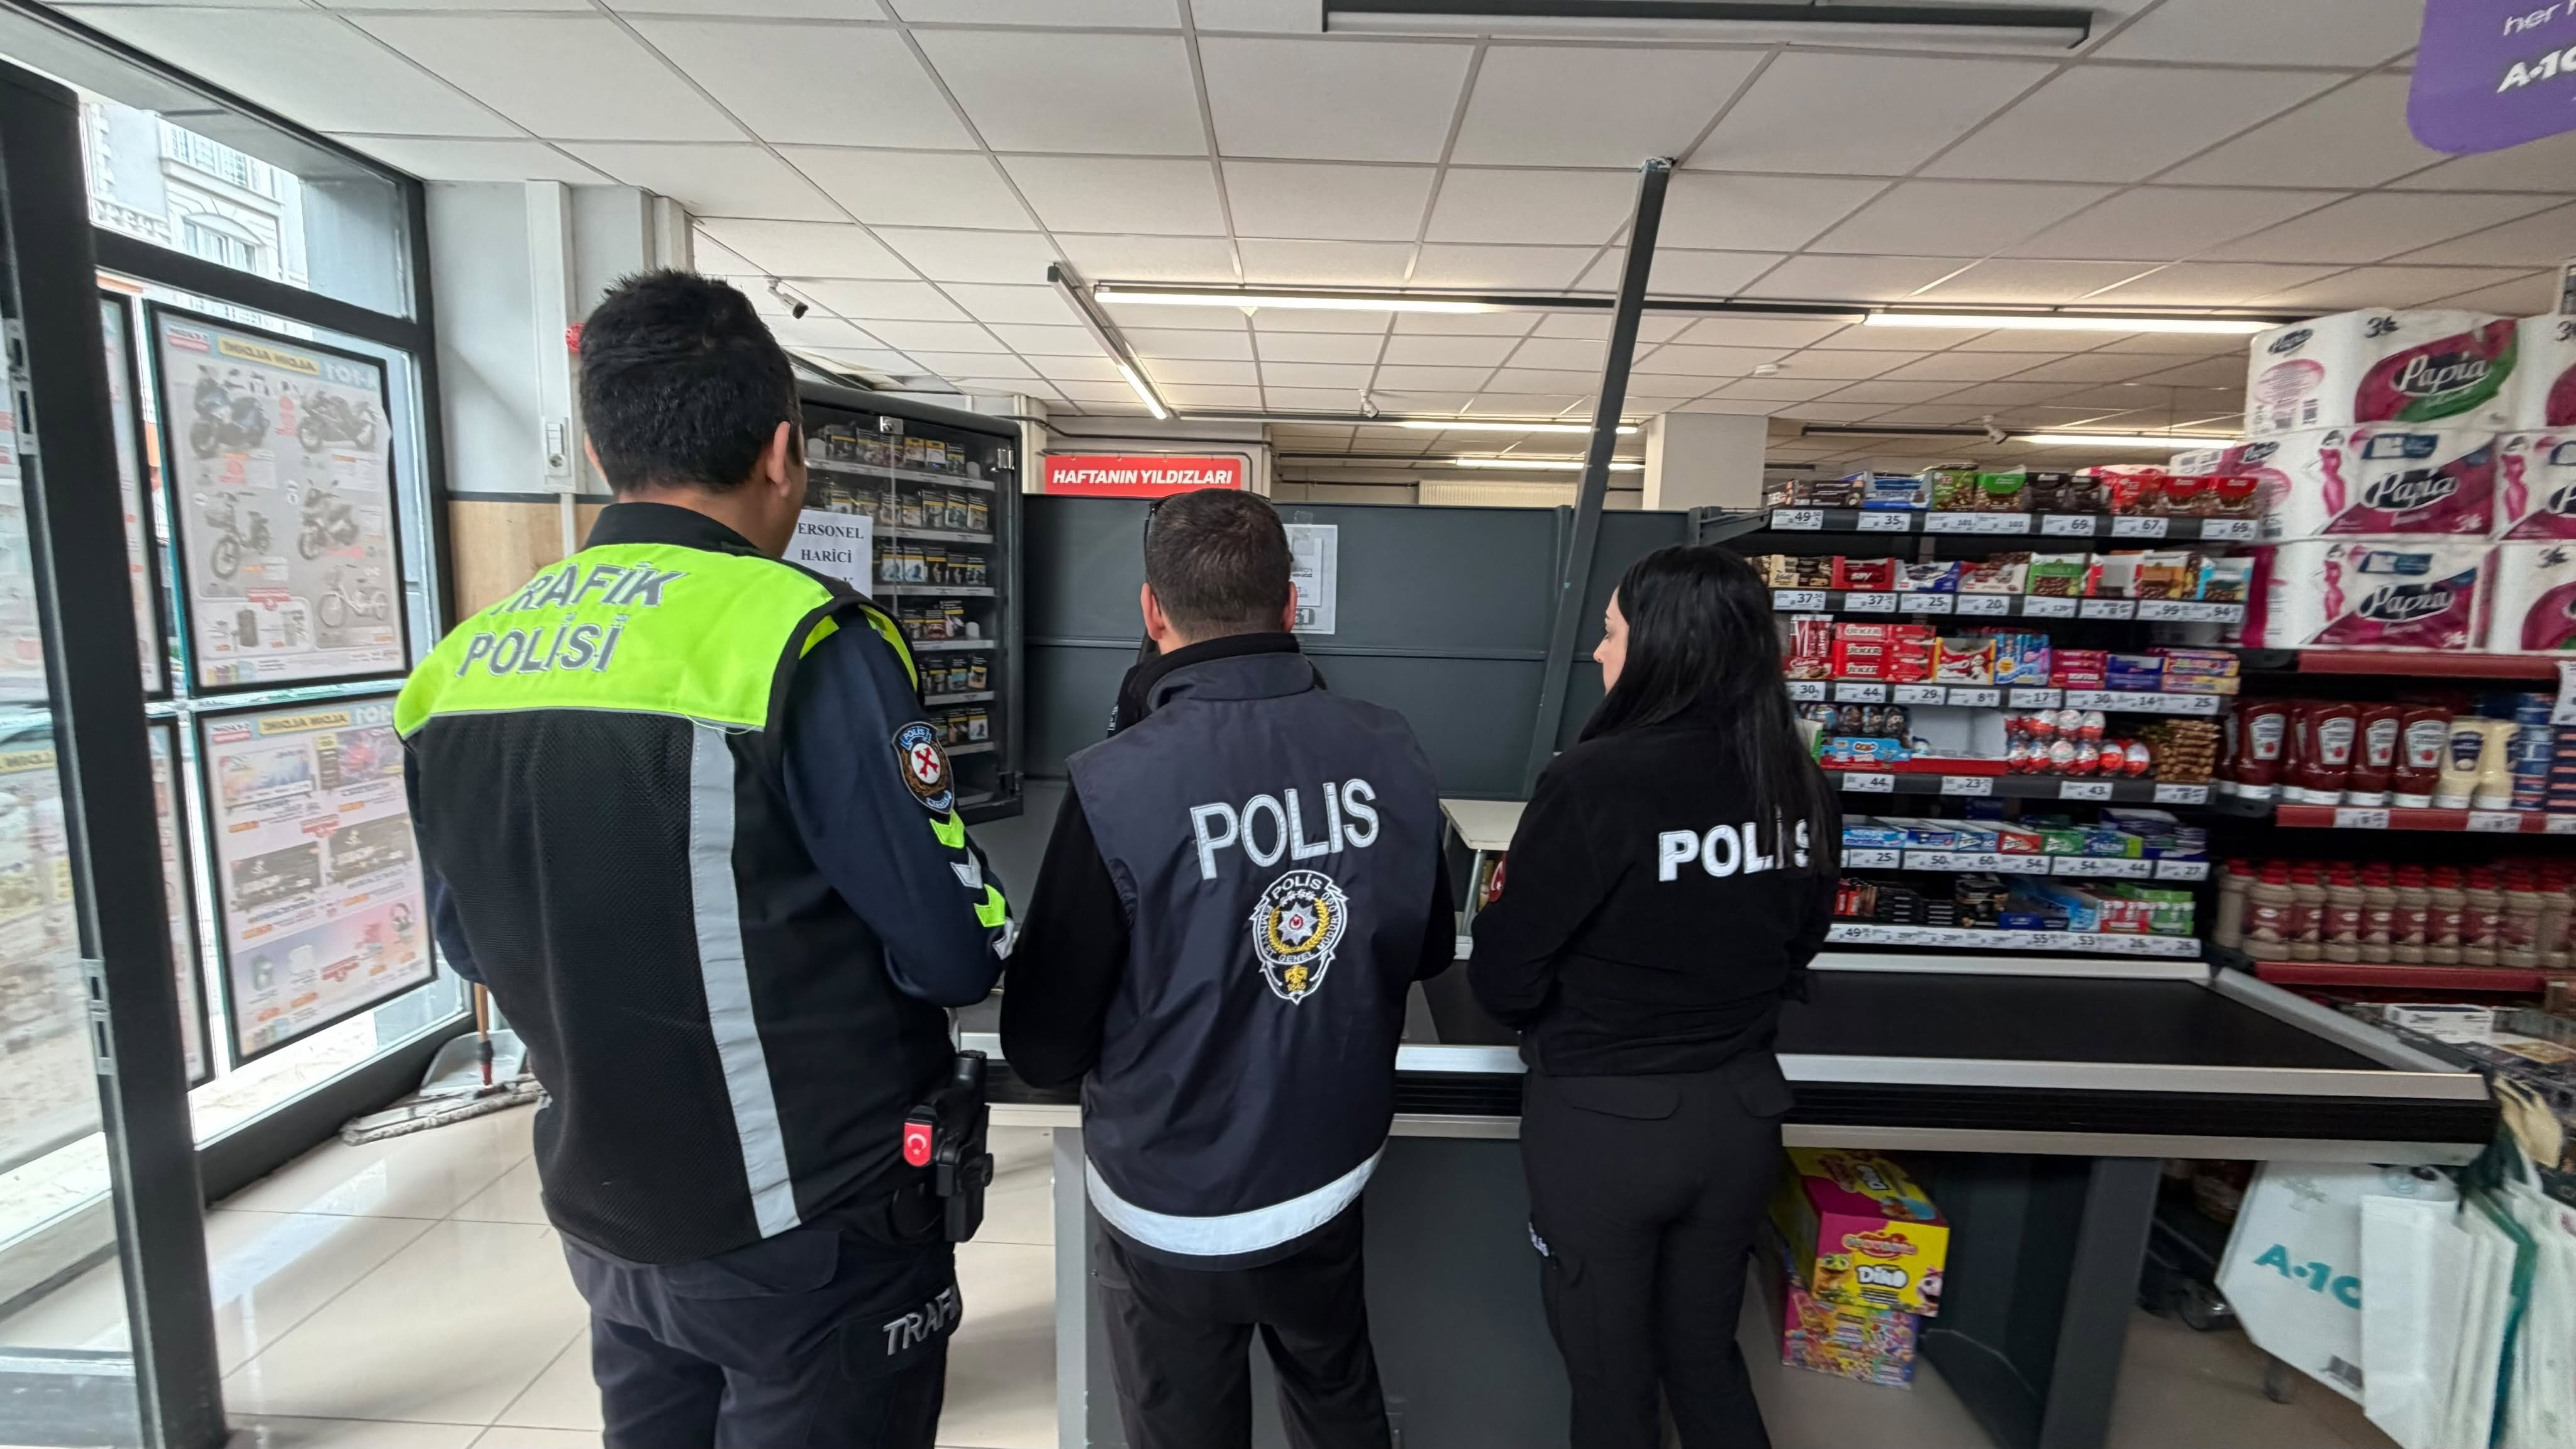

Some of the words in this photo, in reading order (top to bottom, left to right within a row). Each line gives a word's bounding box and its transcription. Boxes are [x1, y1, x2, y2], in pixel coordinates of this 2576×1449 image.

[2397, 351, 2488, 394] Papia
[1053, 469, 1137, 484] HAFTANIN
[1140, 469, 1233, 484] YILDIZLARI
[2374, 469, 2456, 506] Papia
[1795, 511, 1811, 521] 49
[1884, 515, 1901, 525] 35
[801, 549, 853, 564] HARİCİ
[1797, 593, 1813, 603] 37
[1868, 595, 1884, 605] 37
[1929, 597, 1944, 607] 25
[2365, 583, 2452, 619] Papia
[455, 614, 629, 677] POLİSİ
[1799, 685, 1815, 694] 30
[1863, 687, 1878, 697] 44
[1870, 777, 1885, 786] 44
[1876, 853, 1892, 862] 25
[1272, 874, 1322, 900] POLİS
